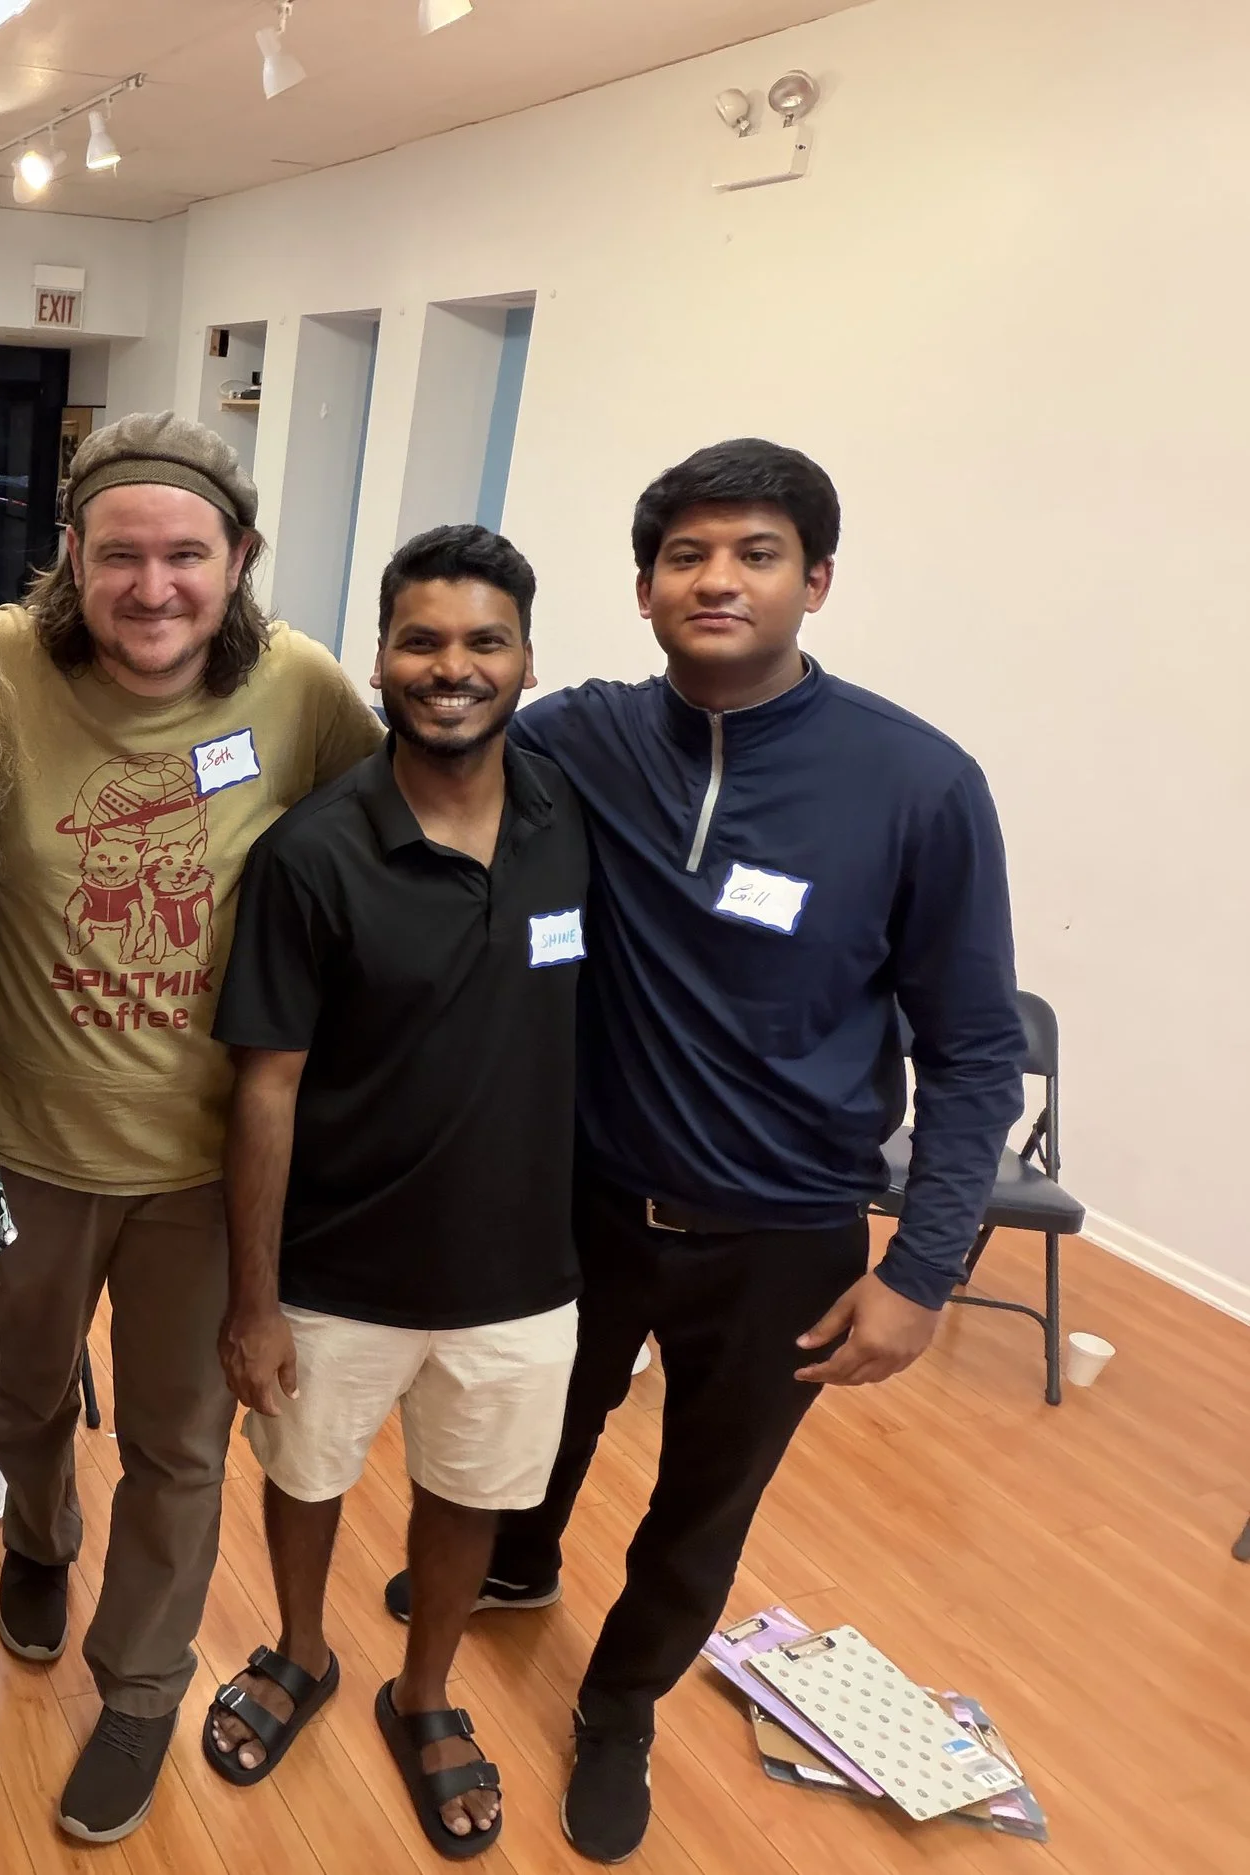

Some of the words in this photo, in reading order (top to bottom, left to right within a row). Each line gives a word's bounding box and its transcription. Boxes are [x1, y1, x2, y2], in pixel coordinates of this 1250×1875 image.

[38, 293, 76, 323] EXIT
[202, 746, 235, 771] Seth
[730, 883, 771, 906] Gill
[541, 928, 576, 949] SHINE
